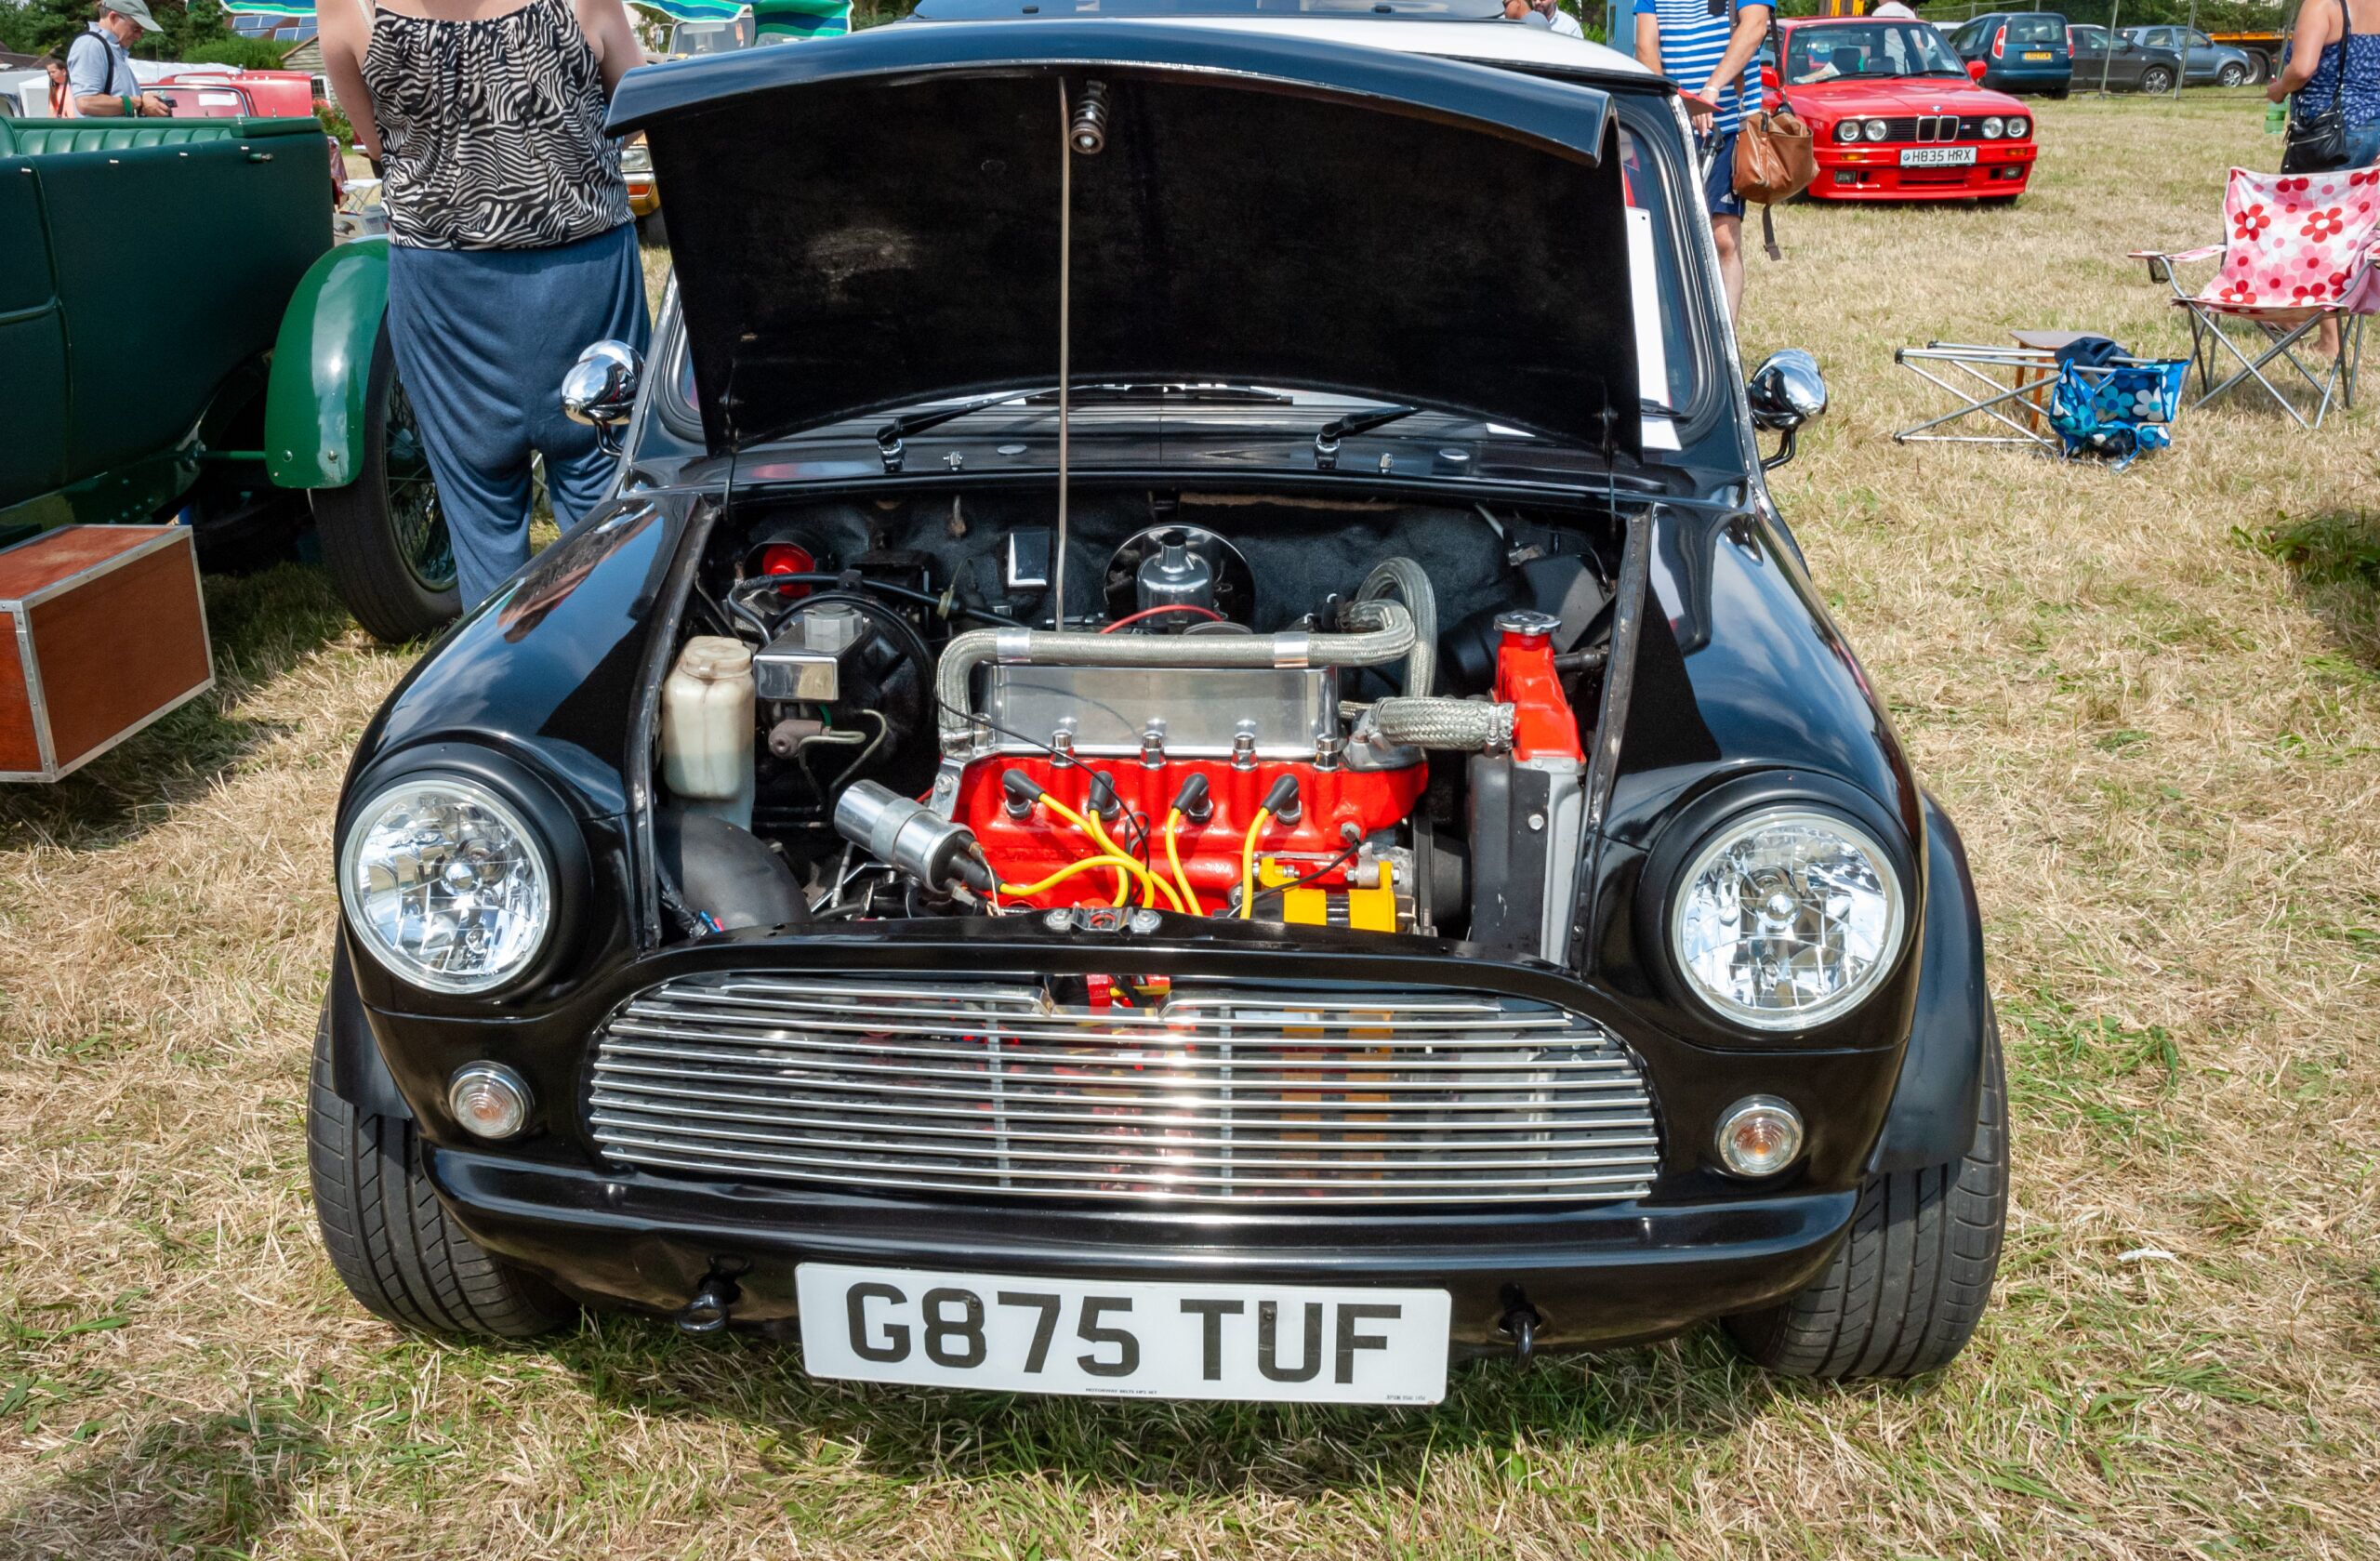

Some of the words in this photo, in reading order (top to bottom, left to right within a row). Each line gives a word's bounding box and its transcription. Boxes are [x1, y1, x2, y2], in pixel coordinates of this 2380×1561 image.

[1912, 151, 1944, 162] H835
[1948, 150, 1971, 161] HRX
[846, 1282, 1140, 1377] G875
[1181, 1299, 1401, 1383] TUF
